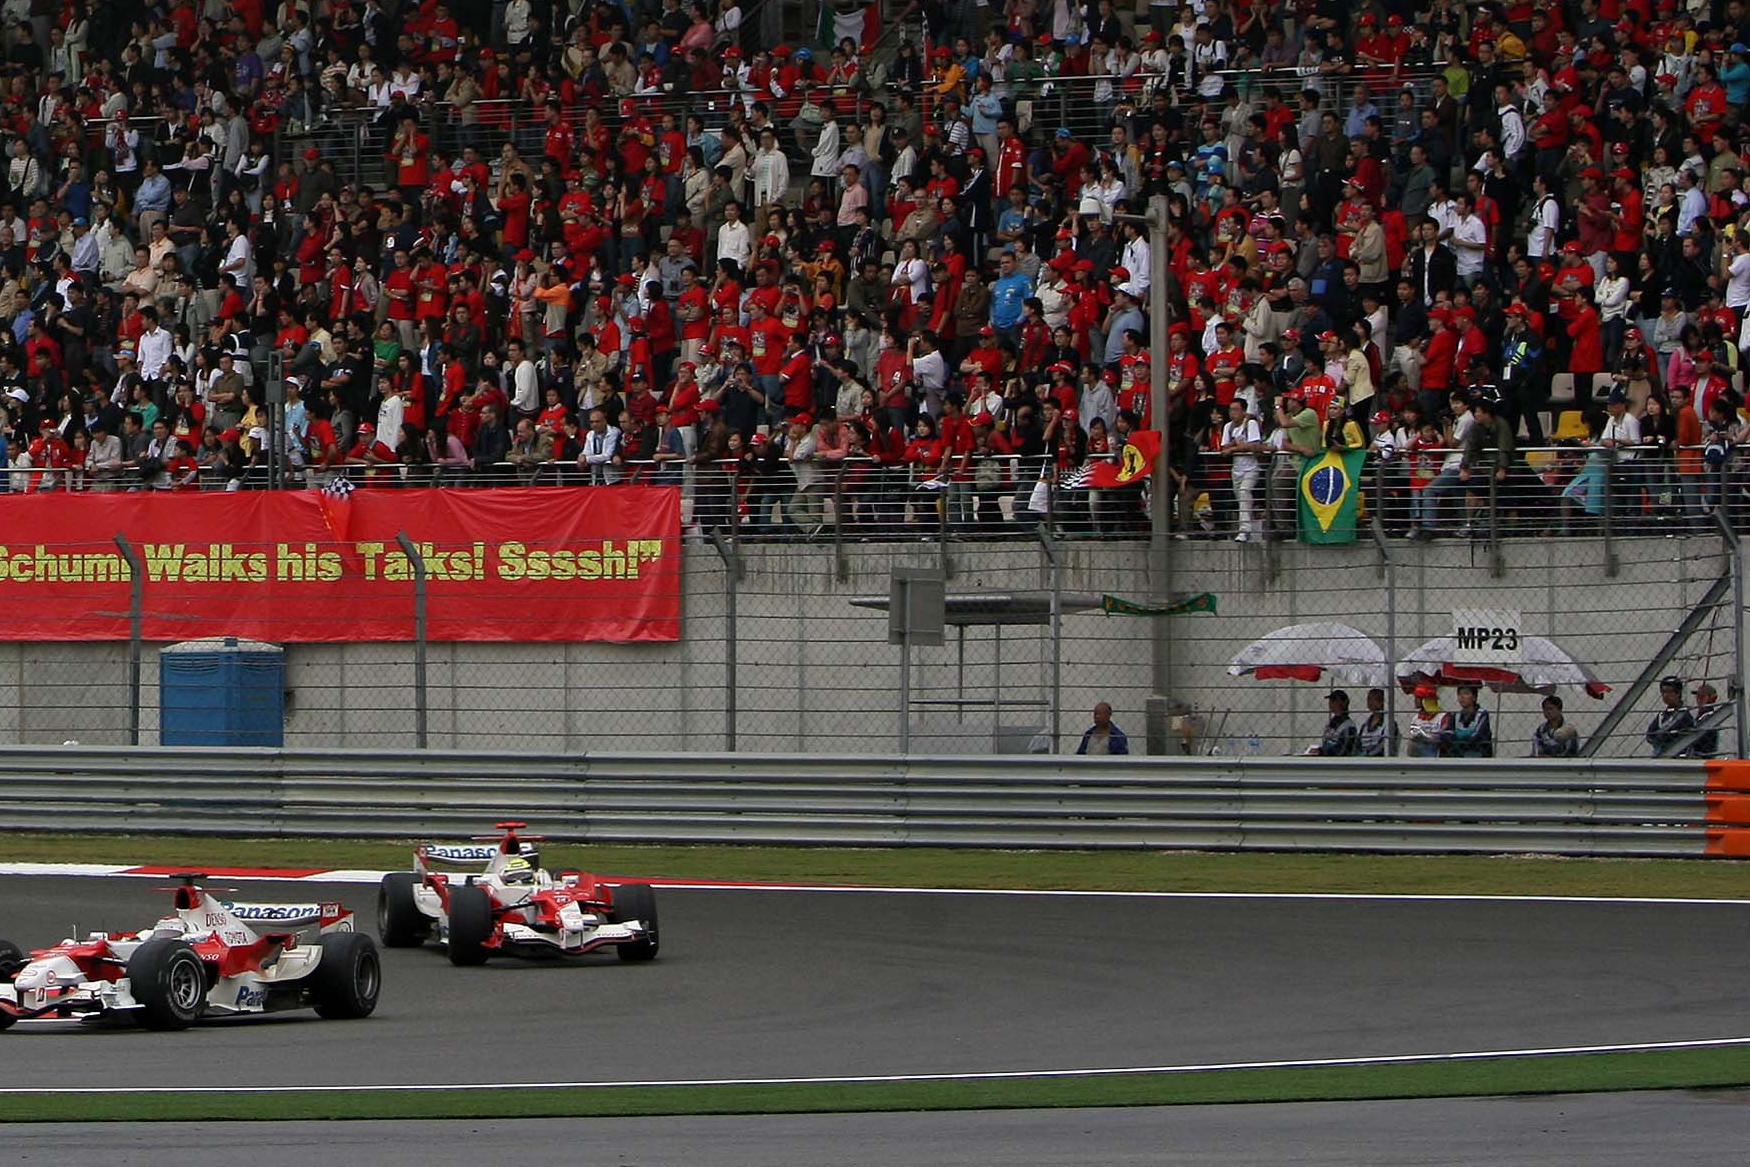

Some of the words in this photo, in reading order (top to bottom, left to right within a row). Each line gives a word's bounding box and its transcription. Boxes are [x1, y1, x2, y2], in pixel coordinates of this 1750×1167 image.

[143, 544, 267, 582] Walks
[276, 543, 342, 581] his
[1457, 627, 1518, 651] MP23
